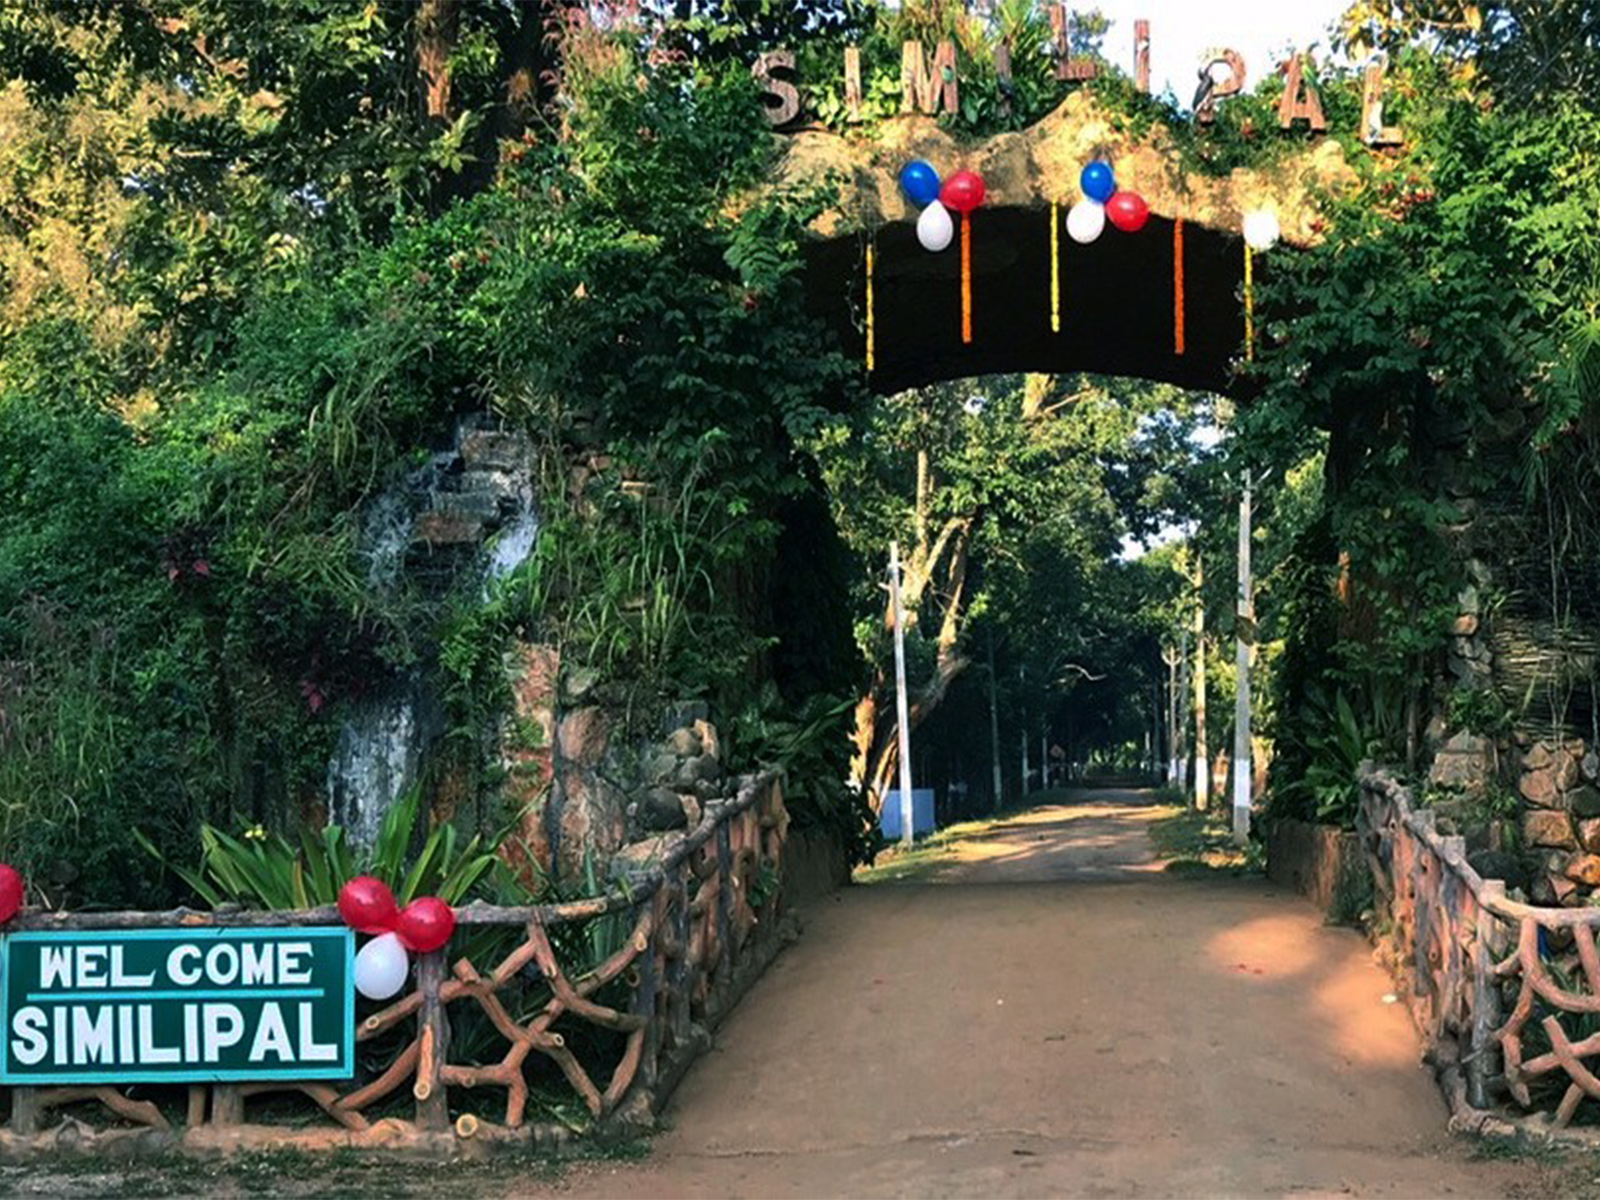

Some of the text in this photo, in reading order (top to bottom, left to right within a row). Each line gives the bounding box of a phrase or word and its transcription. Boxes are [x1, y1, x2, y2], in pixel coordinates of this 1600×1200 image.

[751, 3, 1403, 146] SIMILIPAL
[40, 942, 313, 988] WEL COME
[11, 1002, 338, 1065] SIMILIPAL
